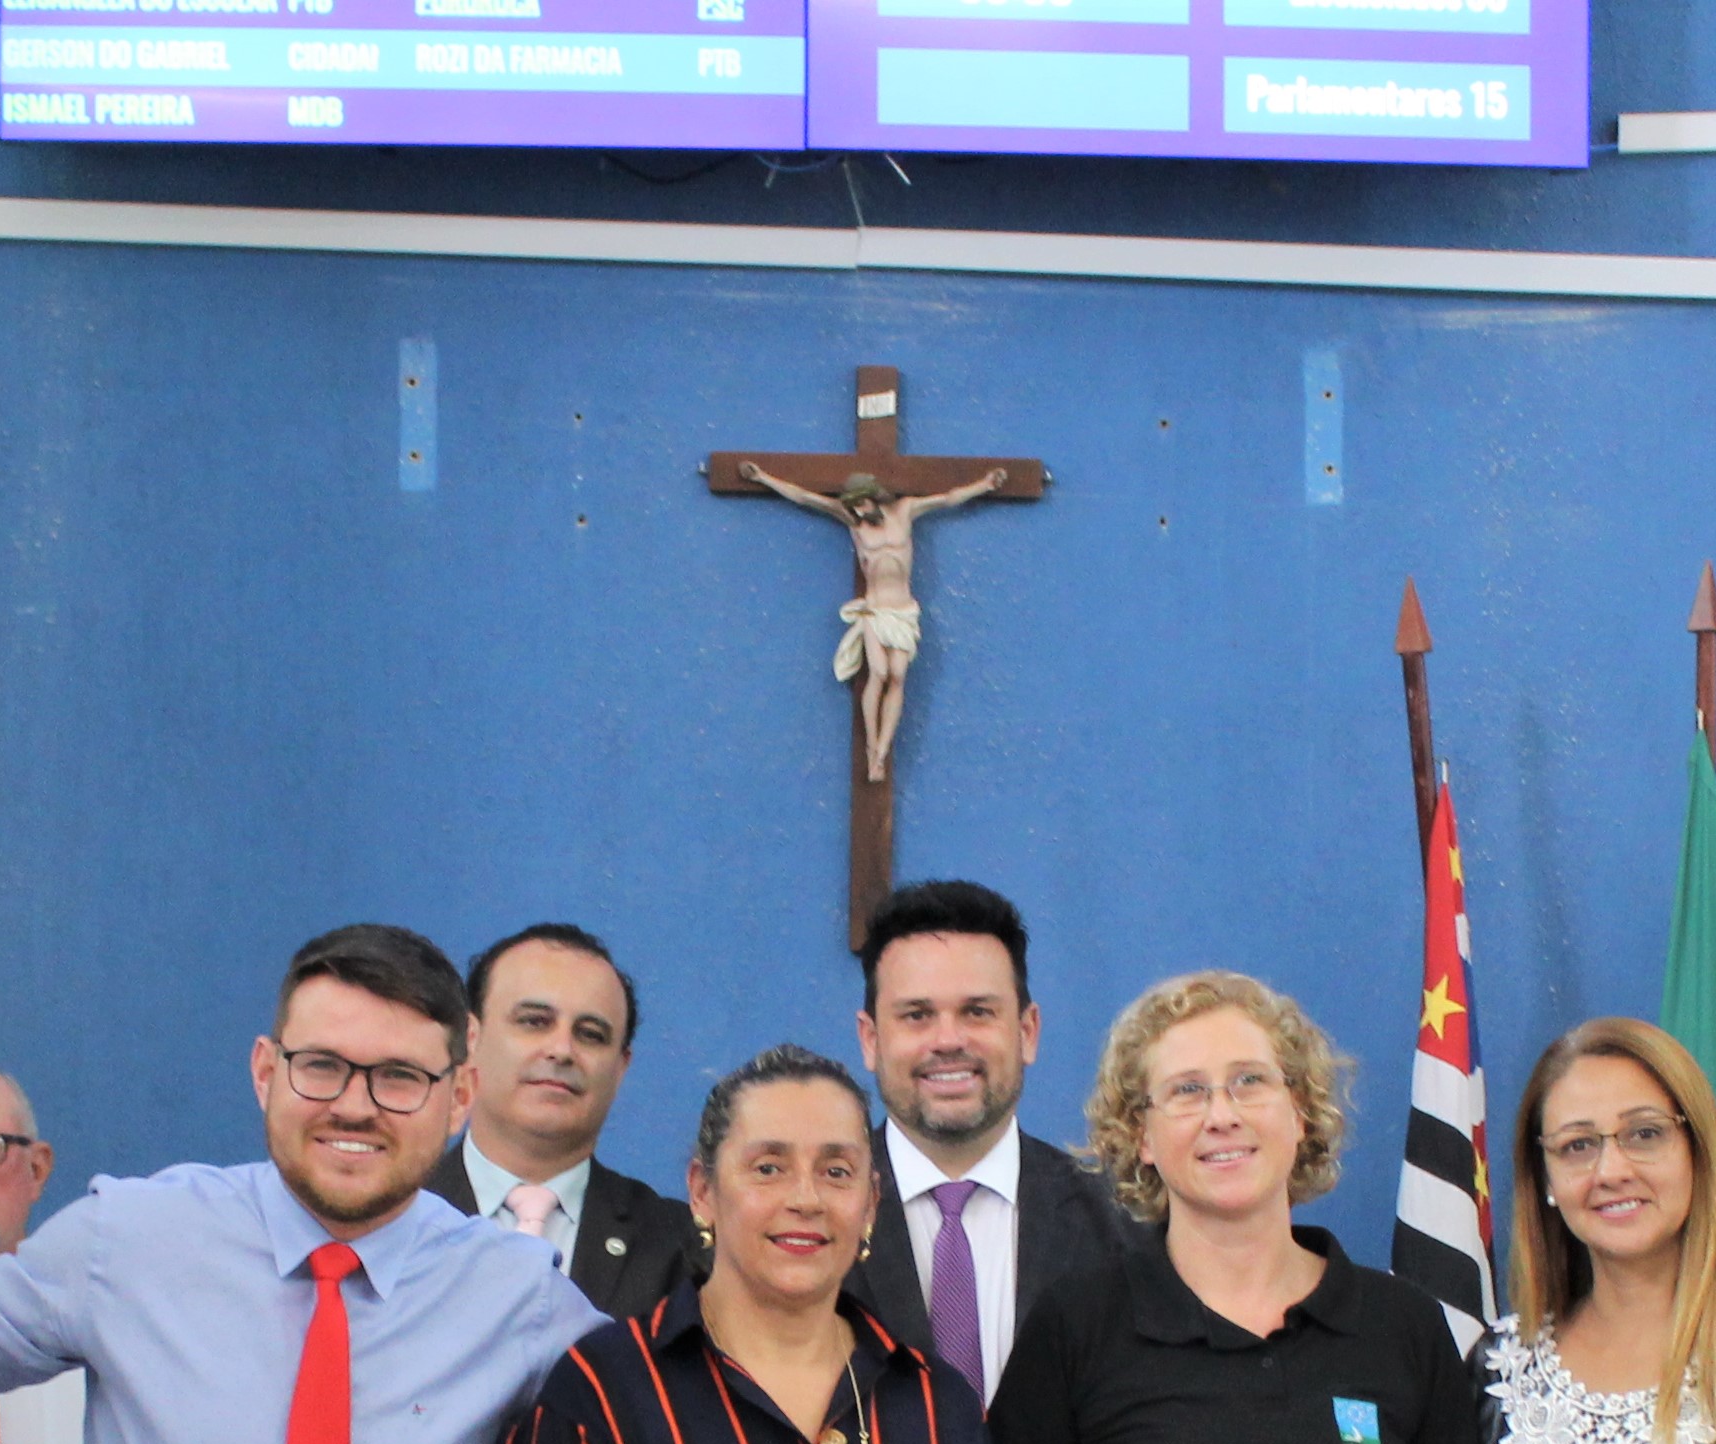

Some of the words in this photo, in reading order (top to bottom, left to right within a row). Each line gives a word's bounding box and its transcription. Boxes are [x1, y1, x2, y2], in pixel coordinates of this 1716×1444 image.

[3, 39, 95, 69] GERSON
[98, 40, 132, 69] DO
[136, 40, 231, 70] GABRIEL
[415, 43, 469, 74] ROZI
[474, 45, 505, 74] DA
[509, 46, 624, 77] FARMACIA
[697, 48, 743, 78] PTB
[3, 93, 91, 124] ISMAEL
[95, 94, 196, 125] PEREIRA
[287, 96, 344, 127] MDB
[1246, 74, 1464, 119] Parlamentares
[1469, 80, 1509, 120] 15
